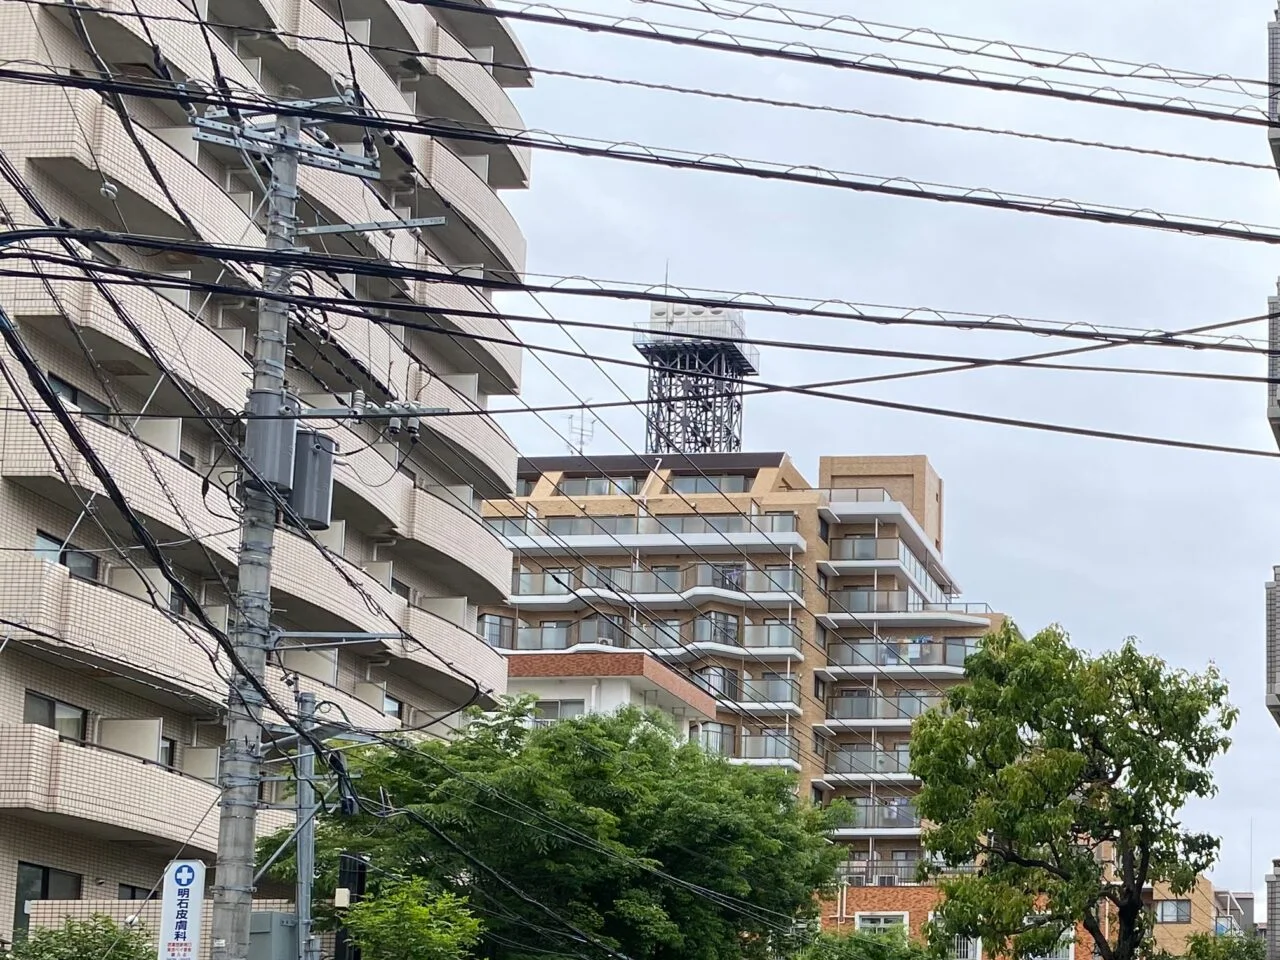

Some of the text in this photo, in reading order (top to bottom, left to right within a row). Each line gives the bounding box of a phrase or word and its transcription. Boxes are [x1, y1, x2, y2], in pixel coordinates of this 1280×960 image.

[174, 888, 190, 942] 明石皮膚科
